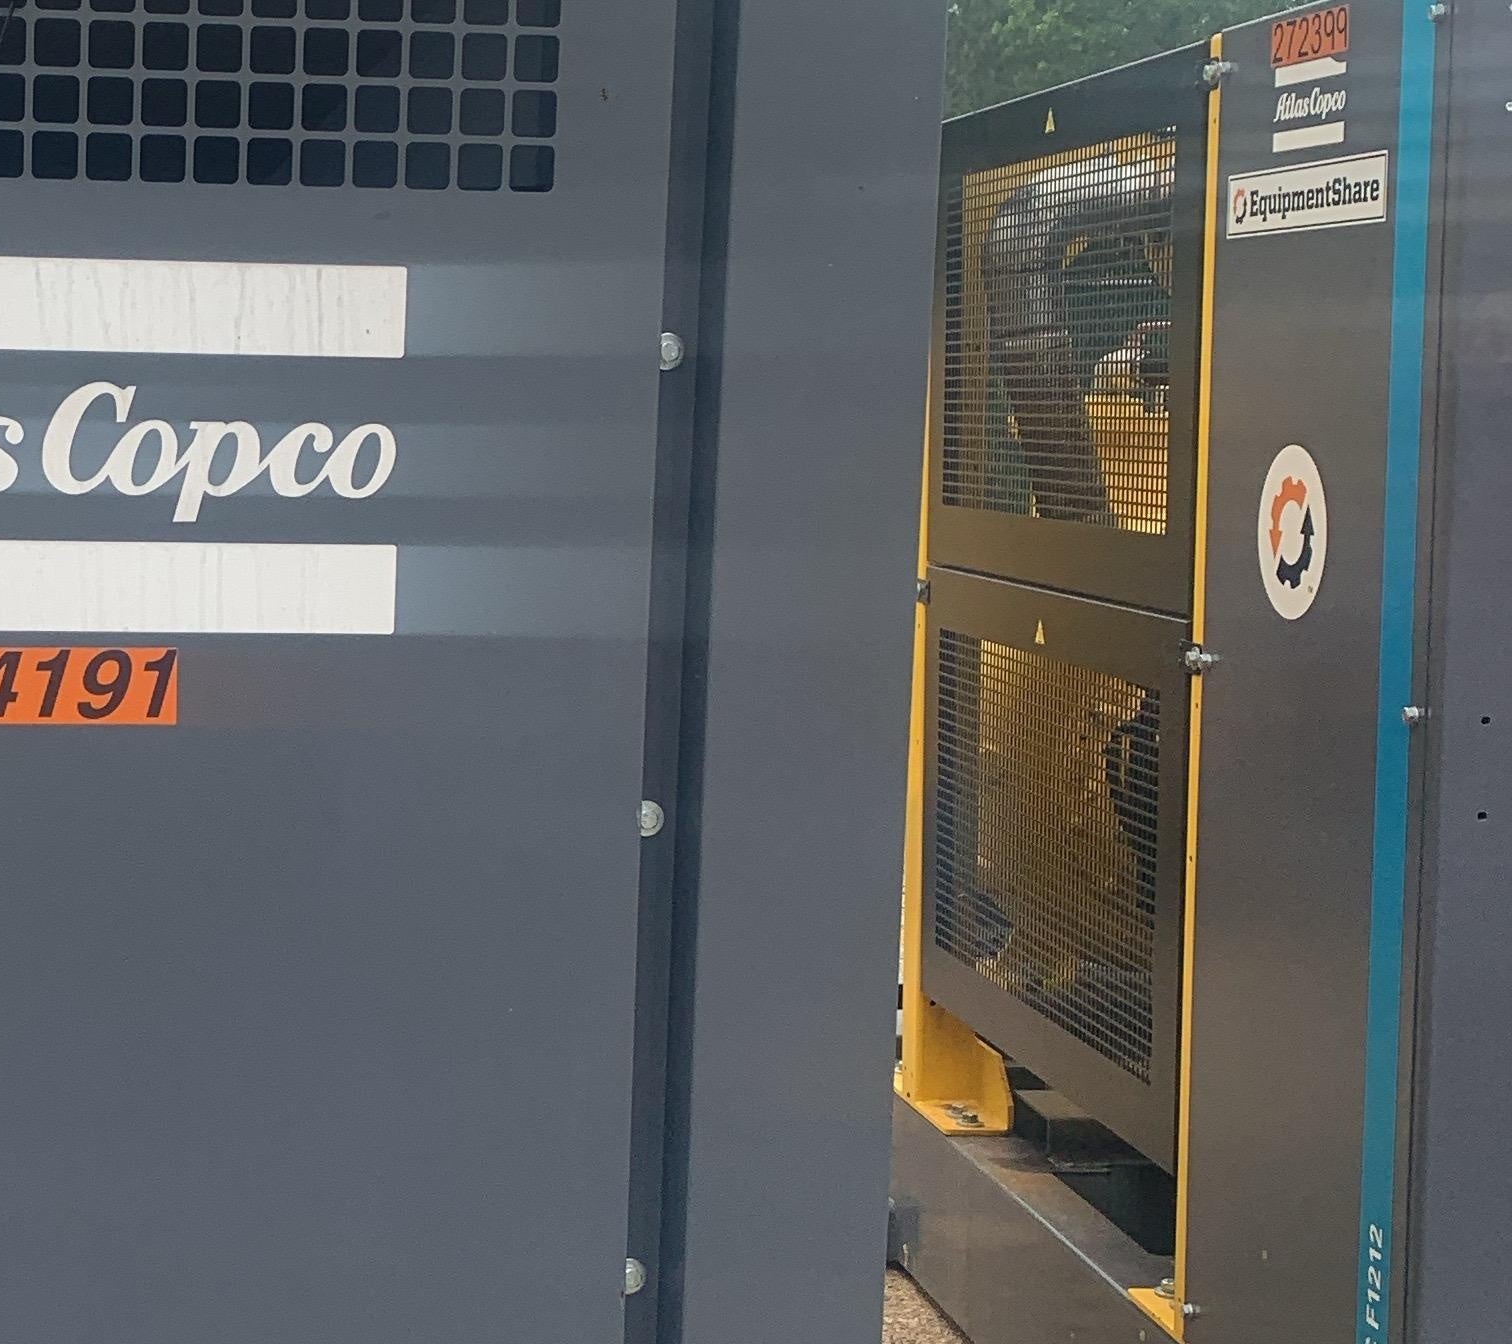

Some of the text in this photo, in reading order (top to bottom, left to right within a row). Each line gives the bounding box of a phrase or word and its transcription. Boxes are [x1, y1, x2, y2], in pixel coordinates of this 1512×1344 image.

[1272, 7, 1348, 65] 272399
[1273, 87, 1347, 123] Atlas Copco
[1249, 176, 1380, 222] EquipmentShare
[41, 380, 397, 523] Copco
[1365, 1223, 1383, 1331] F1212
